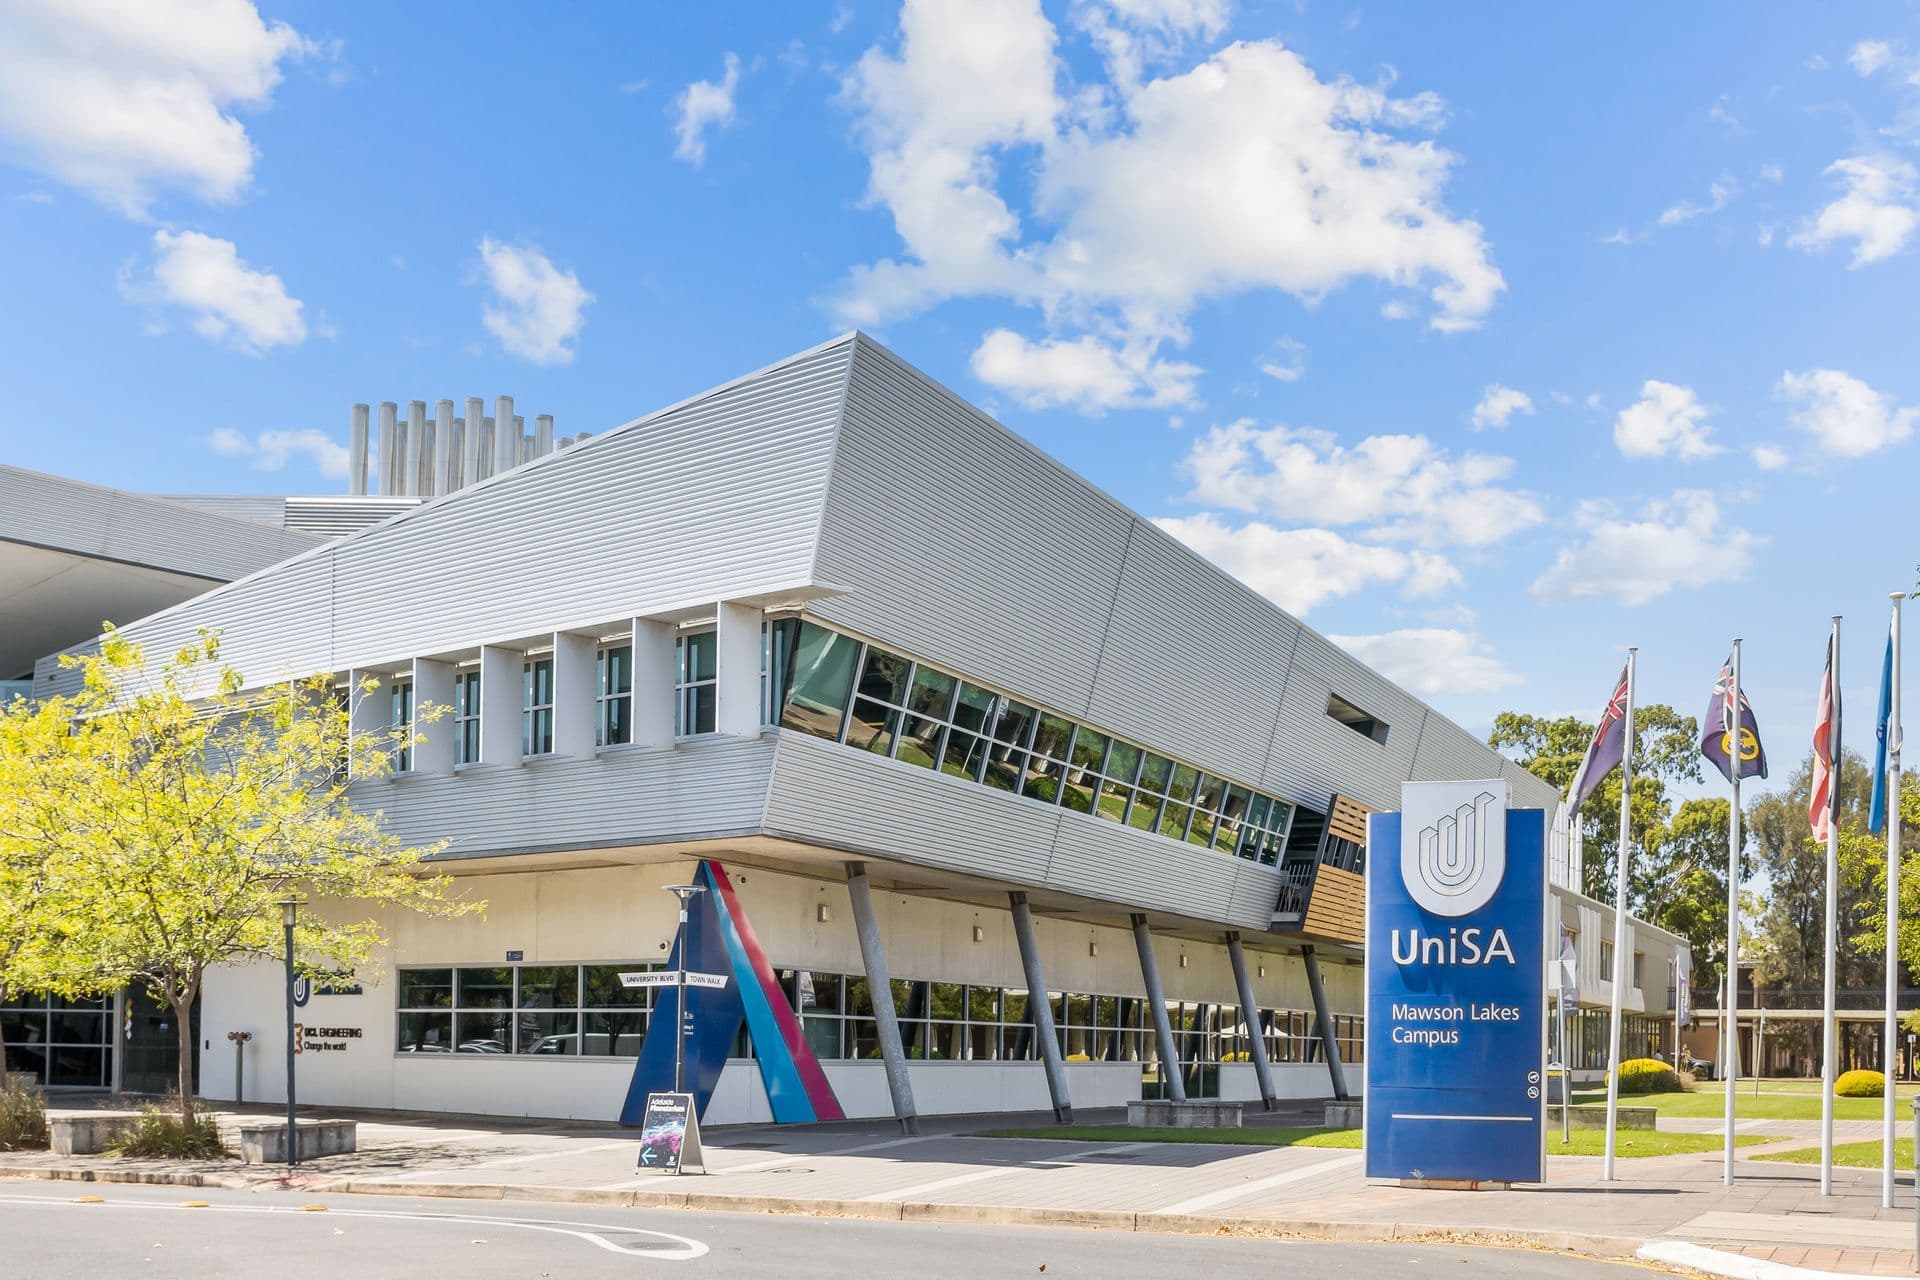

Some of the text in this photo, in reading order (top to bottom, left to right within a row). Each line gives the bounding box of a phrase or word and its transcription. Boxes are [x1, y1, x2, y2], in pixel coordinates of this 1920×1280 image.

[1391, 928, 1516, 965] UniSA
[626, 975, 658, 983] UNIVERSITY
[690, 975, 721, 985] TOWN WALK
[1392, 1003, 1520, 1021] Mawson Lakes
[1392, 1027, 1459, 1048] Campus
